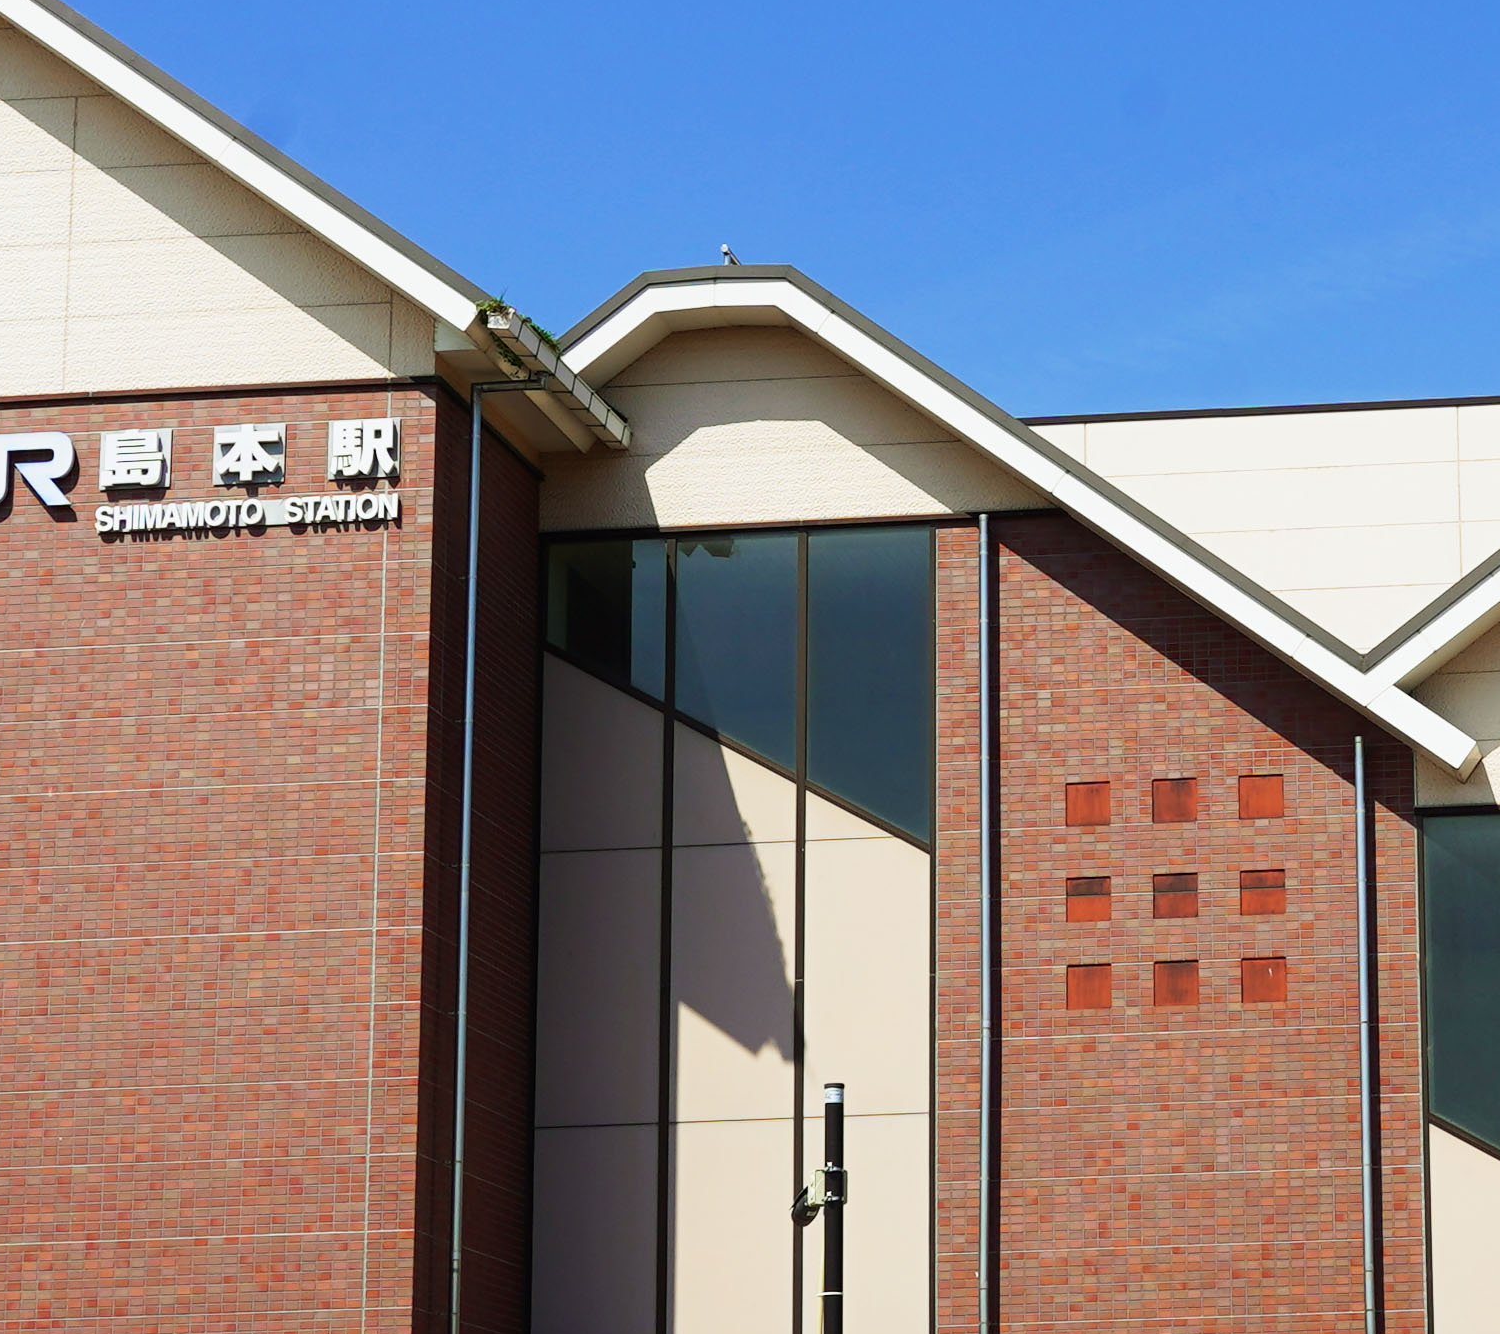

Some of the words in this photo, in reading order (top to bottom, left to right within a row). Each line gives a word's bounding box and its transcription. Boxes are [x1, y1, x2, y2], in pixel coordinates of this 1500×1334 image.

[100, 418, 398, 489] 島本駅
[94, 498, 264, 534] SHIMAMOTO
[284, 493, 399, 525] STATION
